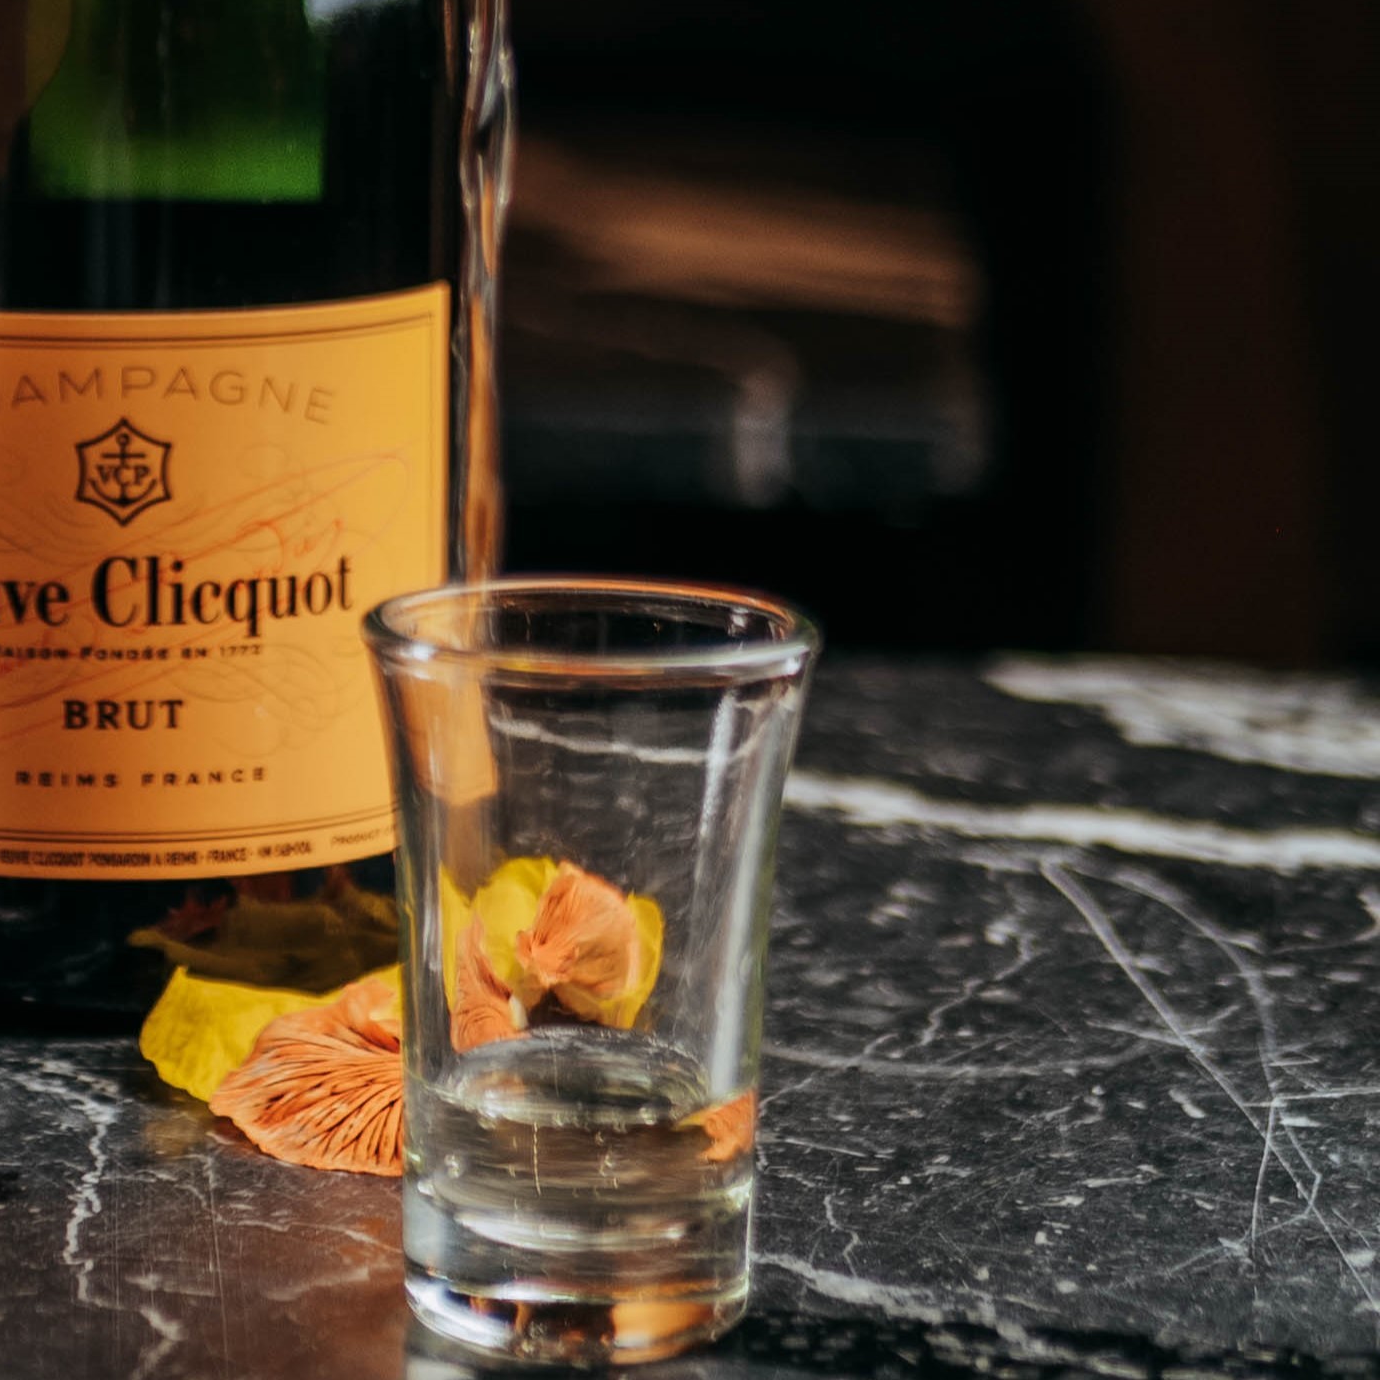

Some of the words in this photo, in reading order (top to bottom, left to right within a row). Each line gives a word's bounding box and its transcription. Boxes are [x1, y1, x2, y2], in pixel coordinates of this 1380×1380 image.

[92, 554, 353, 638] Clicquot
[63, 699, 183, 731] BRUT
[15, 770, 119, 788] REIMS
[141, 767, 265, 787] FRANCE
